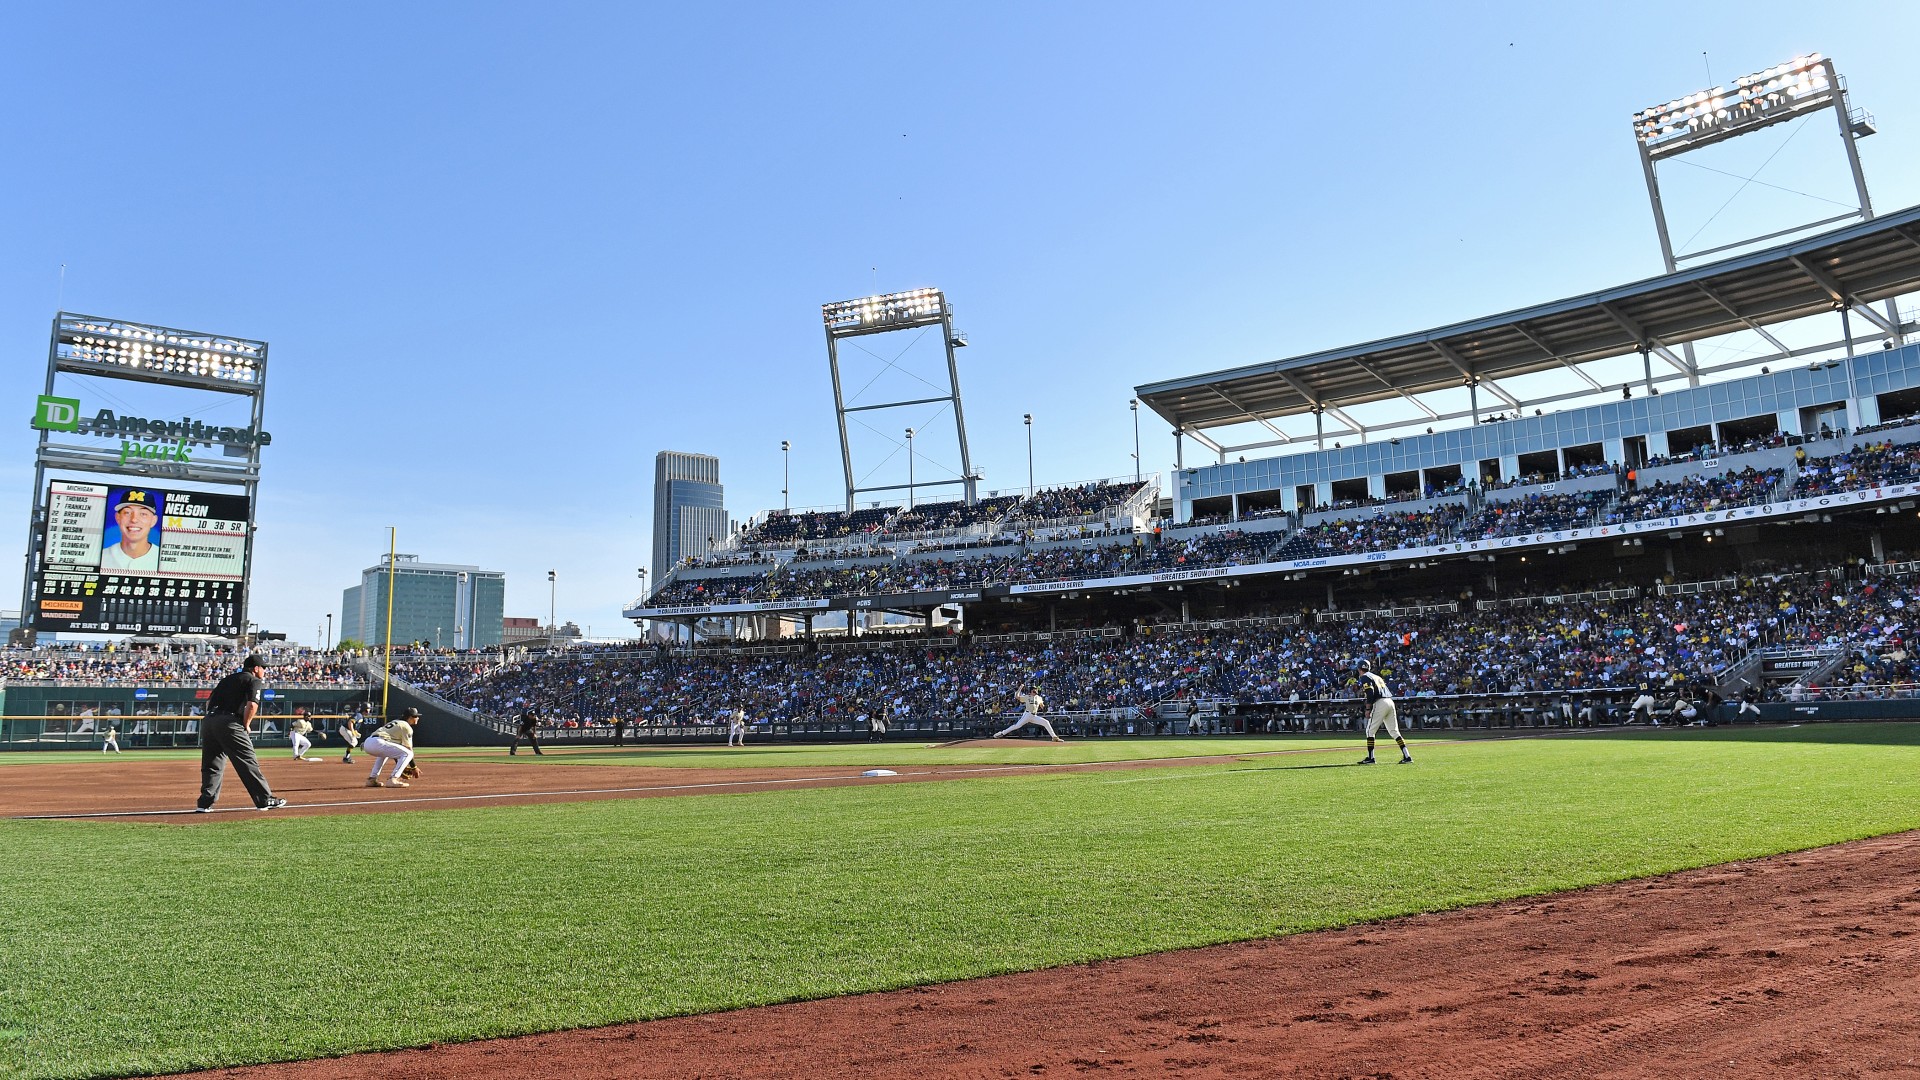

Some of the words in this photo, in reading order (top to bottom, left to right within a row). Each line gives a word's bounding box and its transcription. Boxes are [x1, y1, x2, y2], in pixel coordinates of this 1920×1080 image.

[41, 401, 75, 424] TD
[92, 408, 272, 446] Ameritrade
[119, 436, 193, 466] park
[128, 491, 145, 502] M
[166, 493, 190, 503] BLAKE
[165, 503, 209, 517] NELSON
[168, 516, 183, 528] M
[197, 520, 207, 528] 10
[214, 521, 225, 530] 3B
[231, 522, 242, 531] SR
[1366, 552, 1386, 561] #CWS
[1293, 560, 1327, 568] NCAA.com
[1161, 571, 1189, 580] GREATEST
[1190, 570, 1207, 578] SHOW
[1214, 568, 1229, 576] DIRT
[1027, 583, 1048, 591] COLLEGE
[1049, 582, 1065, 590] WORLD
[1066, 581, 1084, 589] SERIES
[120, 585, 131, 595] 42
[133, 586, 145, 596] 69
[195, 590, 205, 598] 16
[212, 590, 217, 599] 1
[227, 590, 232, 600] 1
[44, 601, 80, 609] MICHIGAN
[761, 602, 785, 610] GREATEST
[219, 607, 225, 616] 3
[227, 607, 233, 617] 0
[204, 616, 210, 625] 0
[217, 616, 224, 626] 0
[226, 617, 232, 626] 0
[135, 623, 141, 631] 0
[1774, 661, 1801, 669] GREATEST
[1639, 682, 1648, 690] 10
